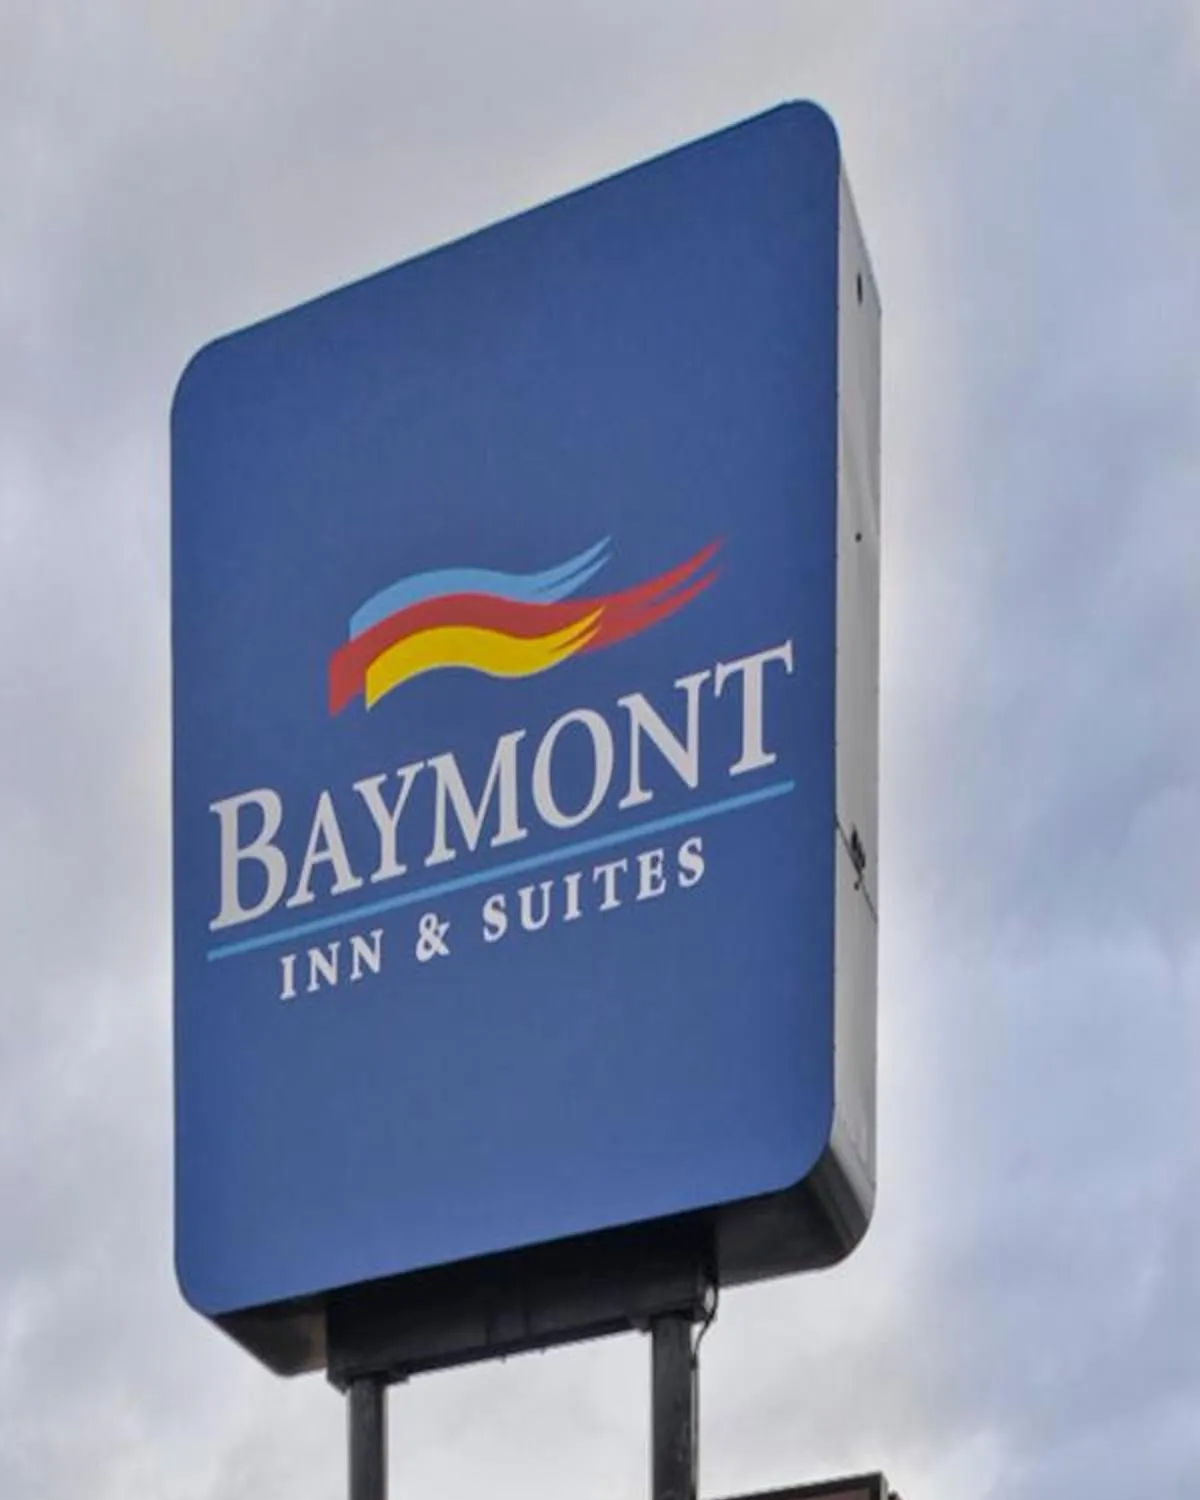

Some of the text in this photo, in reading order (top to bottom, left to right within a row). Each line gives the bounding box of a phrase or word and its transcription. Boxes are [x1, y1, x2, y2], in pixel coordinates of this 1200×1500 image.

[209, 640, 794, 931] BAYMONT
[280, 837, 706, 1000] INN & SUITES
